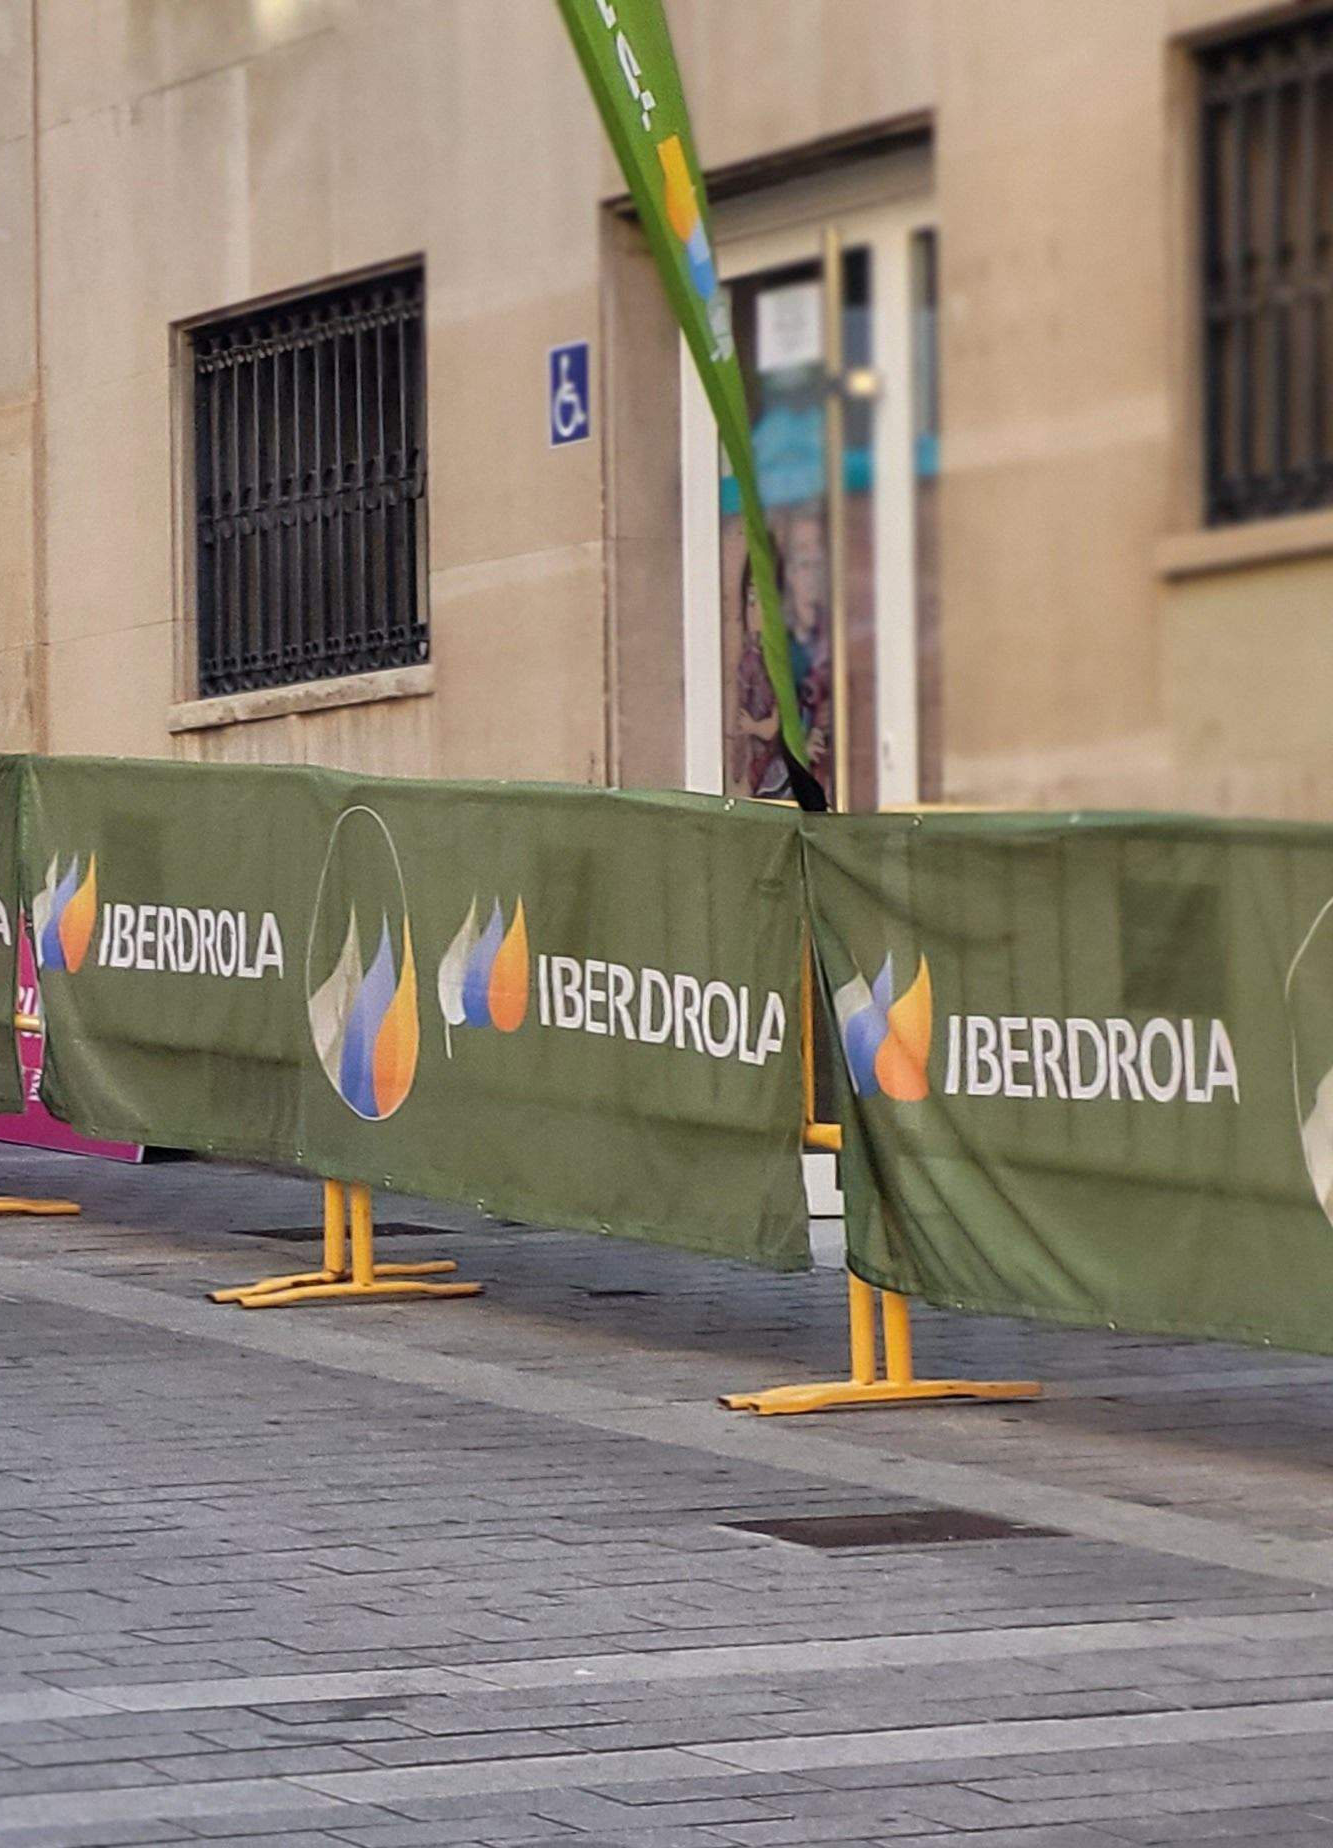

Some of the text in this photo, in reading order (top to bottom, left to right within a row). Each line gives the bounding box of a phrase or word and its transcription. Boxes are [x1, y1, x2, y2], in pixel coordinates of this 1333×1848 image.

[98, 902, 284, 979] IBERDROLA
[538, 953, 787, 1066] IBERDROLA
[945, 1014, 1239, 1104] IBERDROLA
